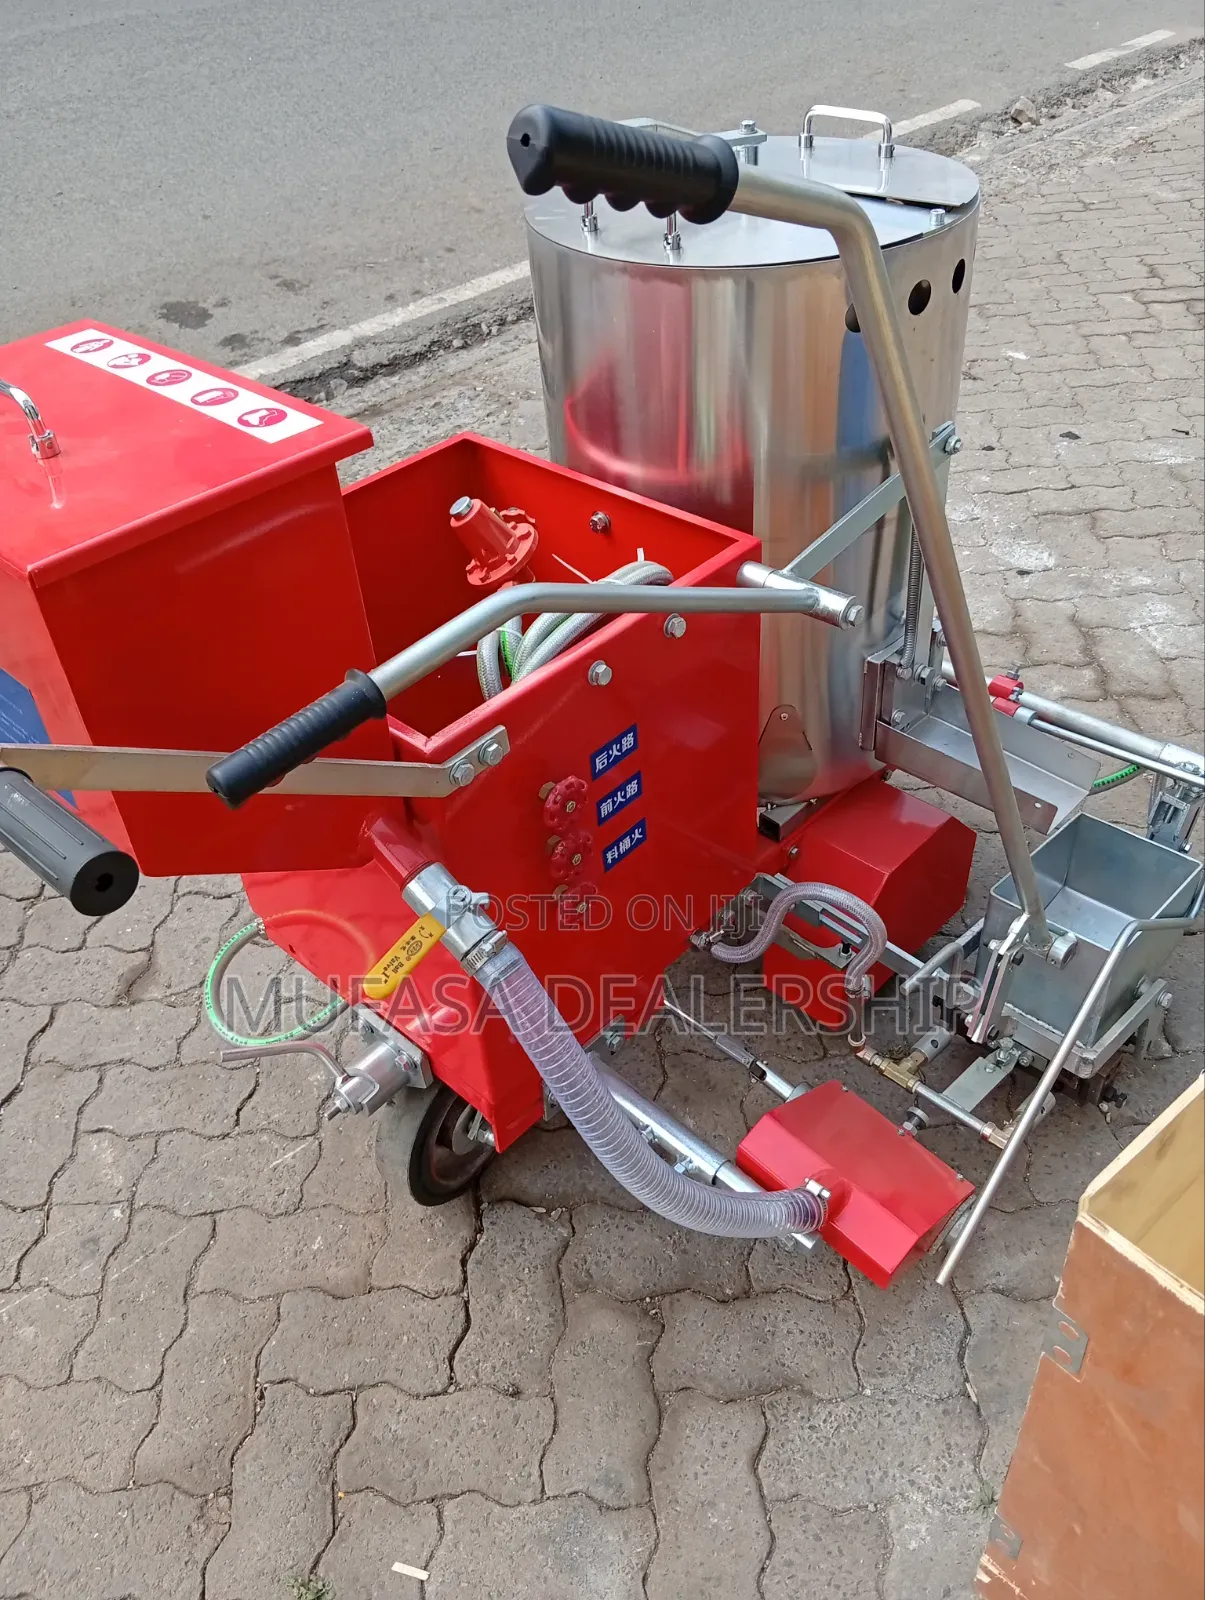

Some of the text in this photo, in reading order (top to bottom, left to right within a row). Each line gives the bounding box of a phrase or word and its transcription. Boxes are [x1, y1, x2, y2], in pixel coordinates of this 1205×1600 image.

[595, 732, 634, 773] 后火路
[600, 779, 638, 818] 前火路
[606, 827, 643, 864] 料桶火
[383, 955, 401, 972] Valve
[391, 961, 405, 974] Ball
